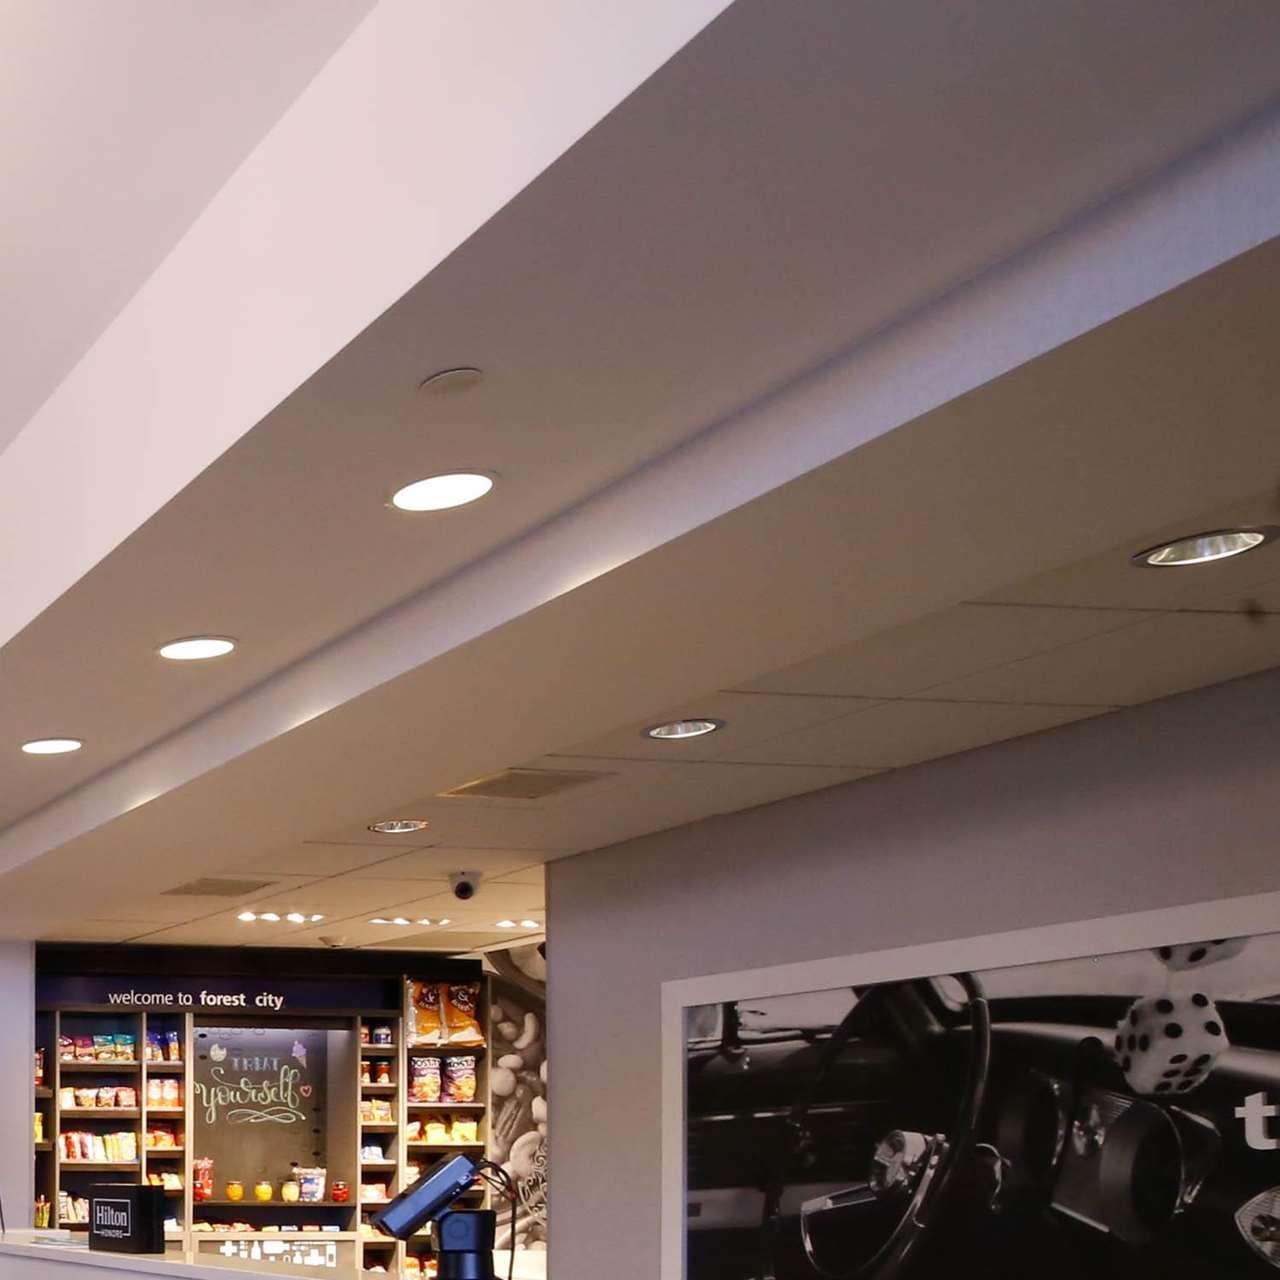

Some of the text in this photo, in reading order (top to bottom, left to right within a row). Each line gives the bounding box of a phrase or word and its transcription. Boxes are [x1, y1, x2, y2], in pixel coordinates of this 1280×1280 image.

[108, 990, 284, 1010] welcome to forest city
[232, 1057, 280, 1072] TREAT
[96, 1206, 128, 1227] Hilton
